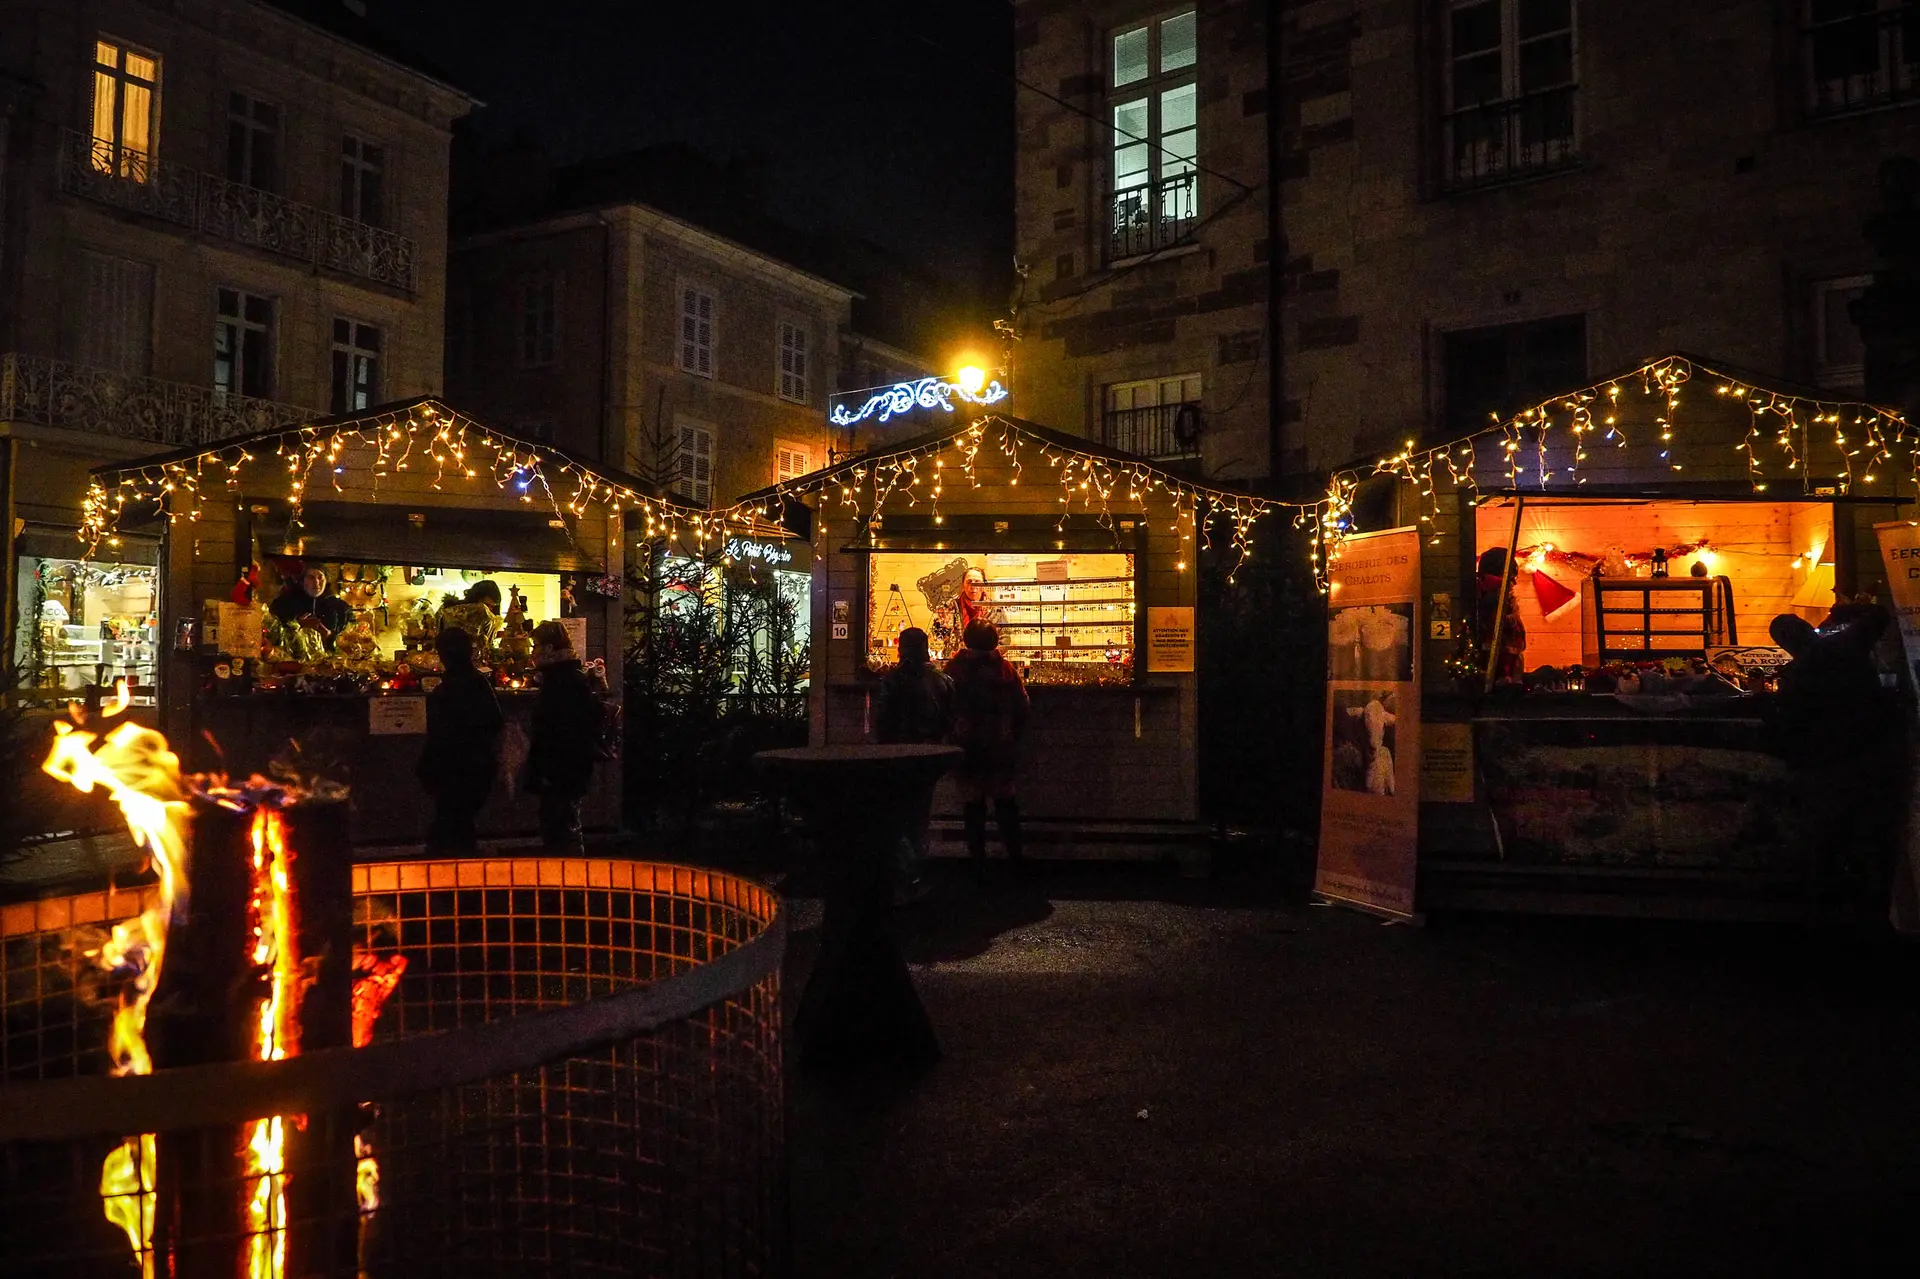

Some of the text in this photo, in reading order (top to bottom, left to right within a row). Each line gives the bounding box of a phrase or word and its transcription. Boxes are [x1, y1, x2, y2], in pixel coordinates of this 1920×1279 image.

[725, 538, 741, 561] Le
[742, 541, 763, 558] Petit
[1330, 555, 1408, 572] BERGERIE DES
[1344, 573, 1391, 587] CHALOTS
[834, 627, 846, 636] 10
[1436, 623, 1446, 636] 2
